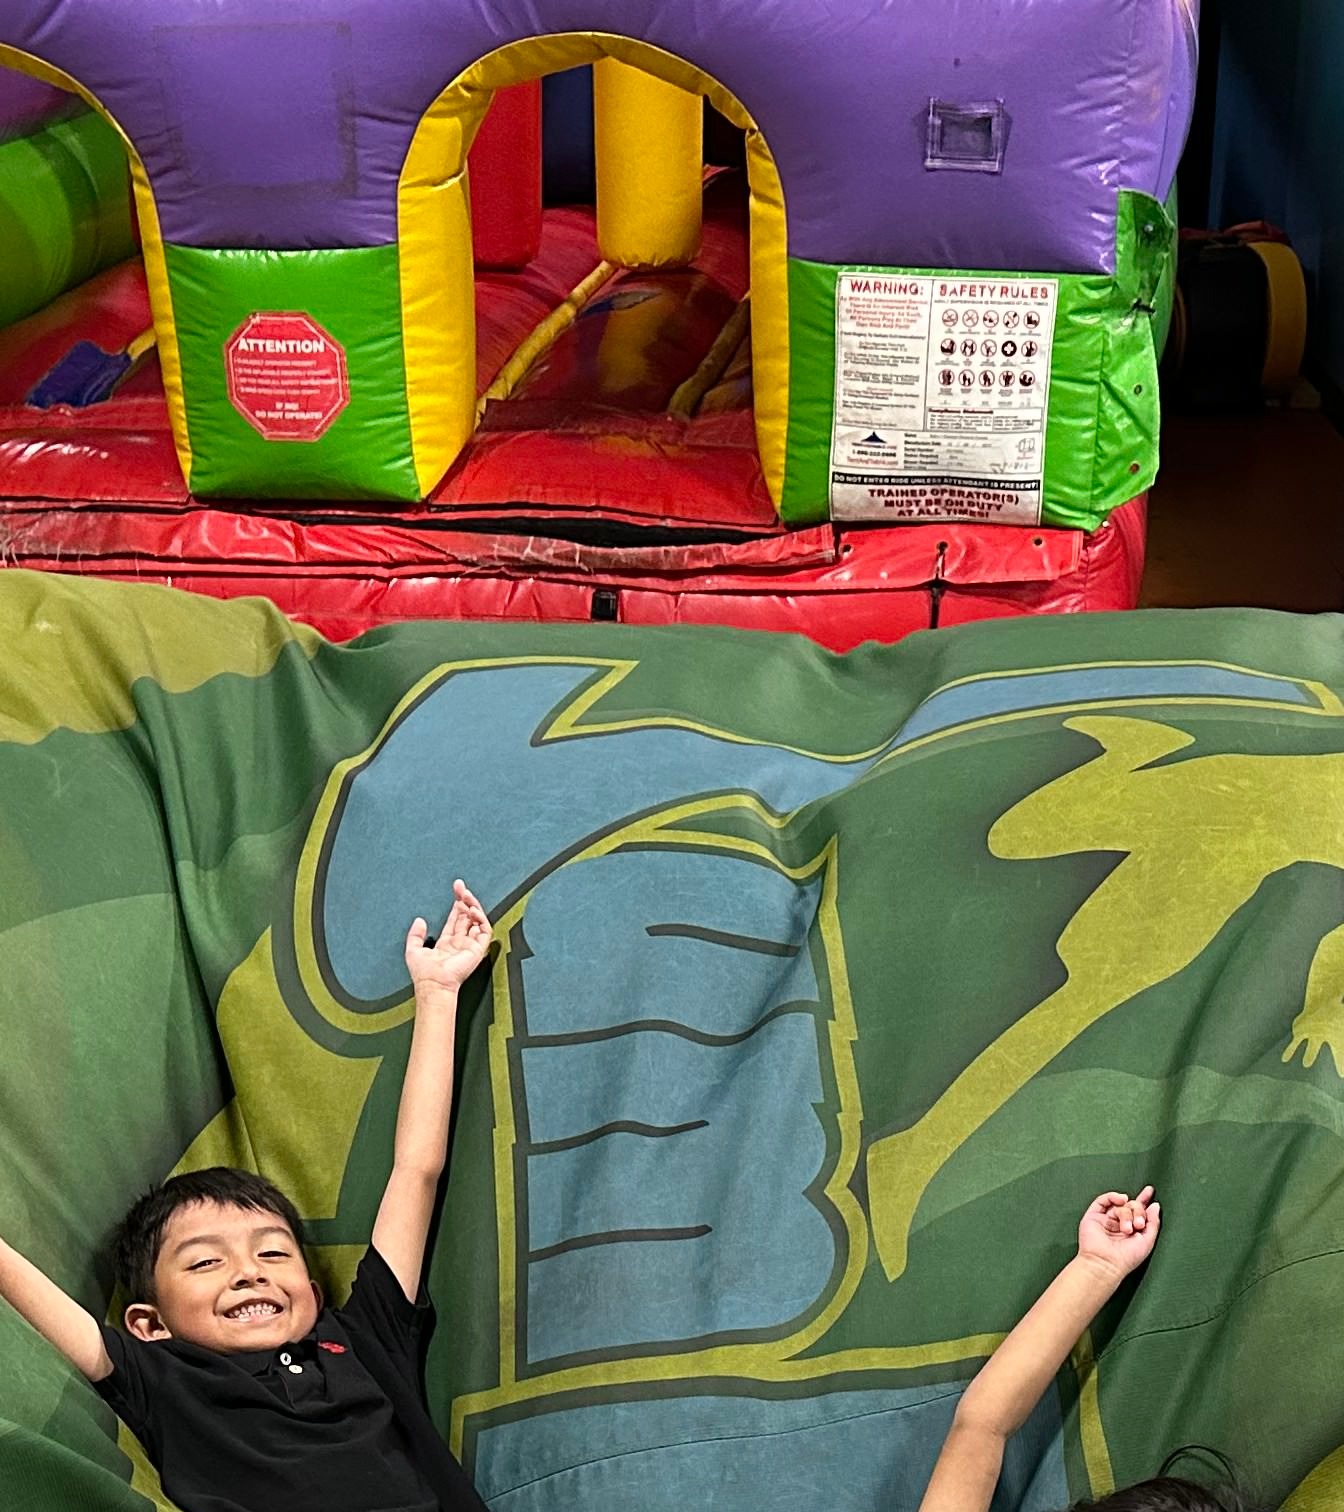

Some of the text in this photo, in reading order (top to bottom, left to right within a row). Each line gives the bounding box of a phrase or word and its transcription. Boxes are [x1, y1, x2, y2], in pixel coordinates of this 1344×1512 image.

[850, 280, 924, 295] WARNING:
[940, 284, 1048, 299] SAFETY RULES
[238, 338, 324, 353] ATTENTION
[868, 488, 1019, 505] TRAINED OPERATOR(S)
[884, 499, 921, 507] MUST
[968, 500, 1003, 511] DUTY
[917, 508, 941, 516] ALL
